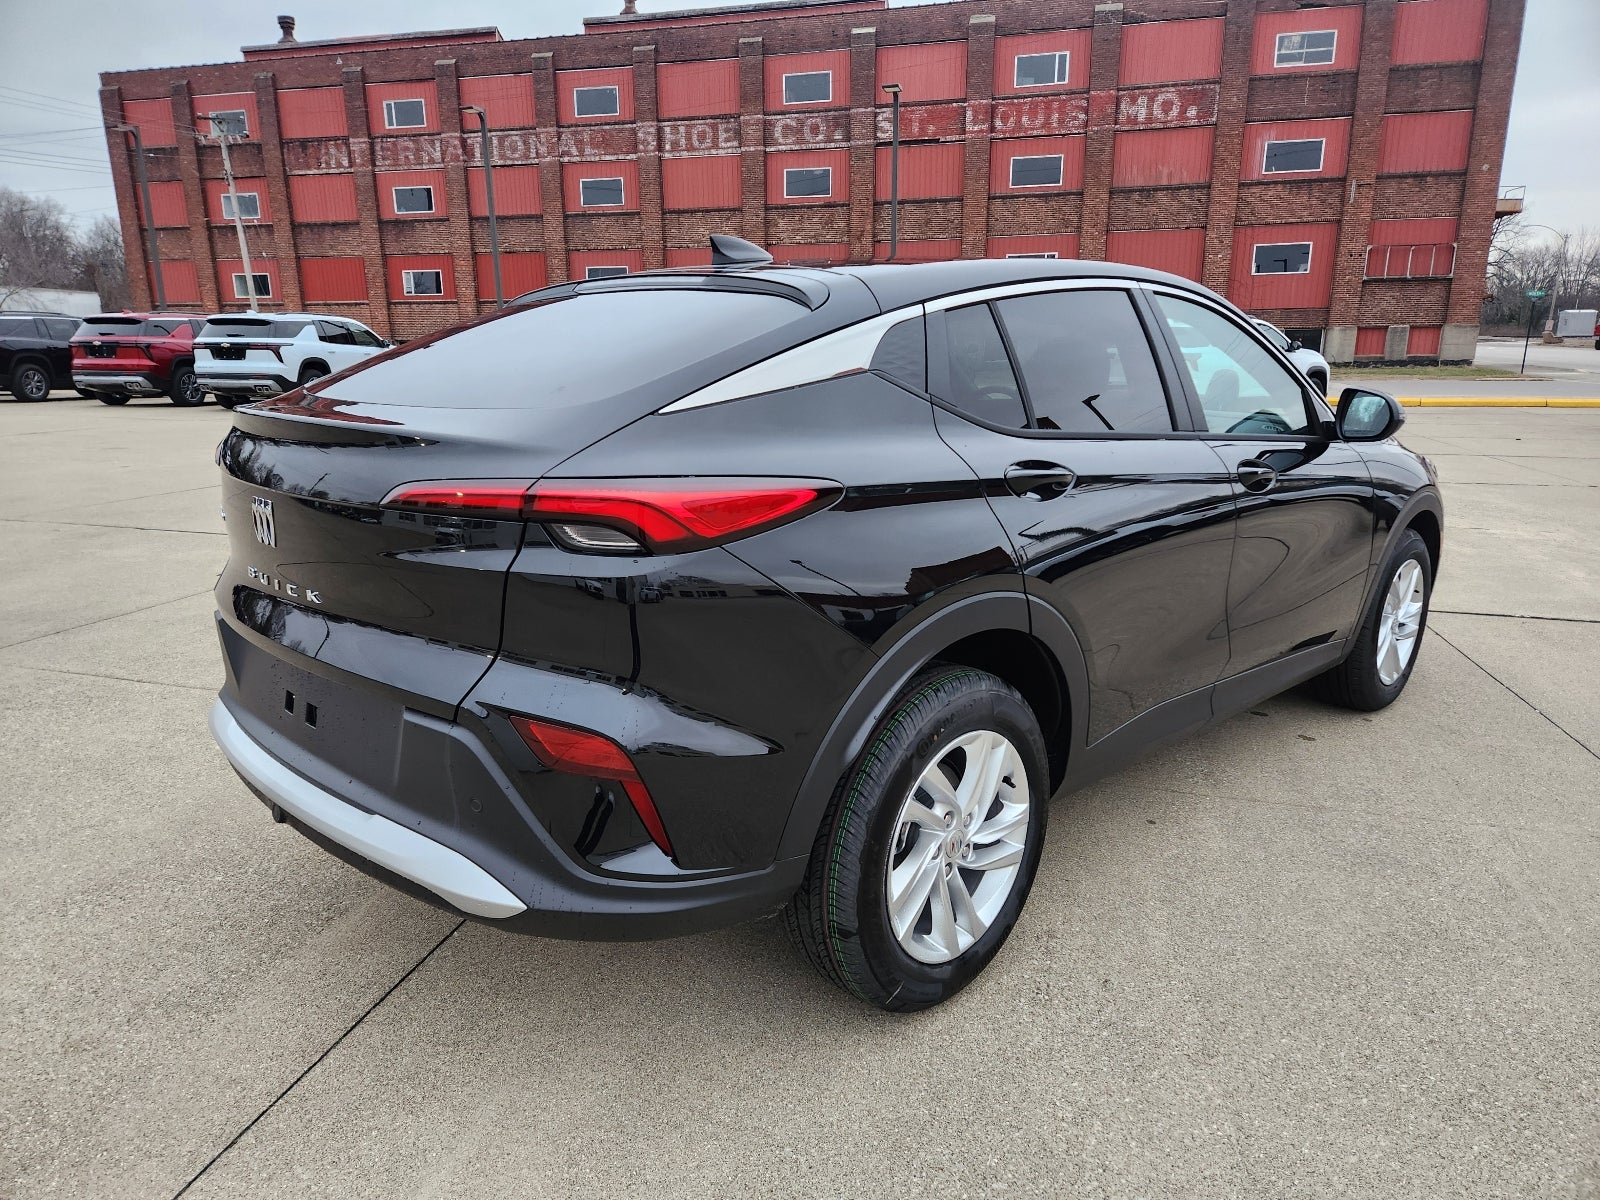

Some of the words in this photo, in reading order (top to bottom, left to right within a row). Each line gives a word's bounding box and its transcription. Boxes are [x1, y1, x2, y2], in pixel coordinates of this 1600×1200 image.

[637, 120, 740, 151] SHOE
[965, 99, 1089, 130] LOUIS
[1119, 93, 1198, 121] MO.
[247, 565, 322, 604] BUICK
